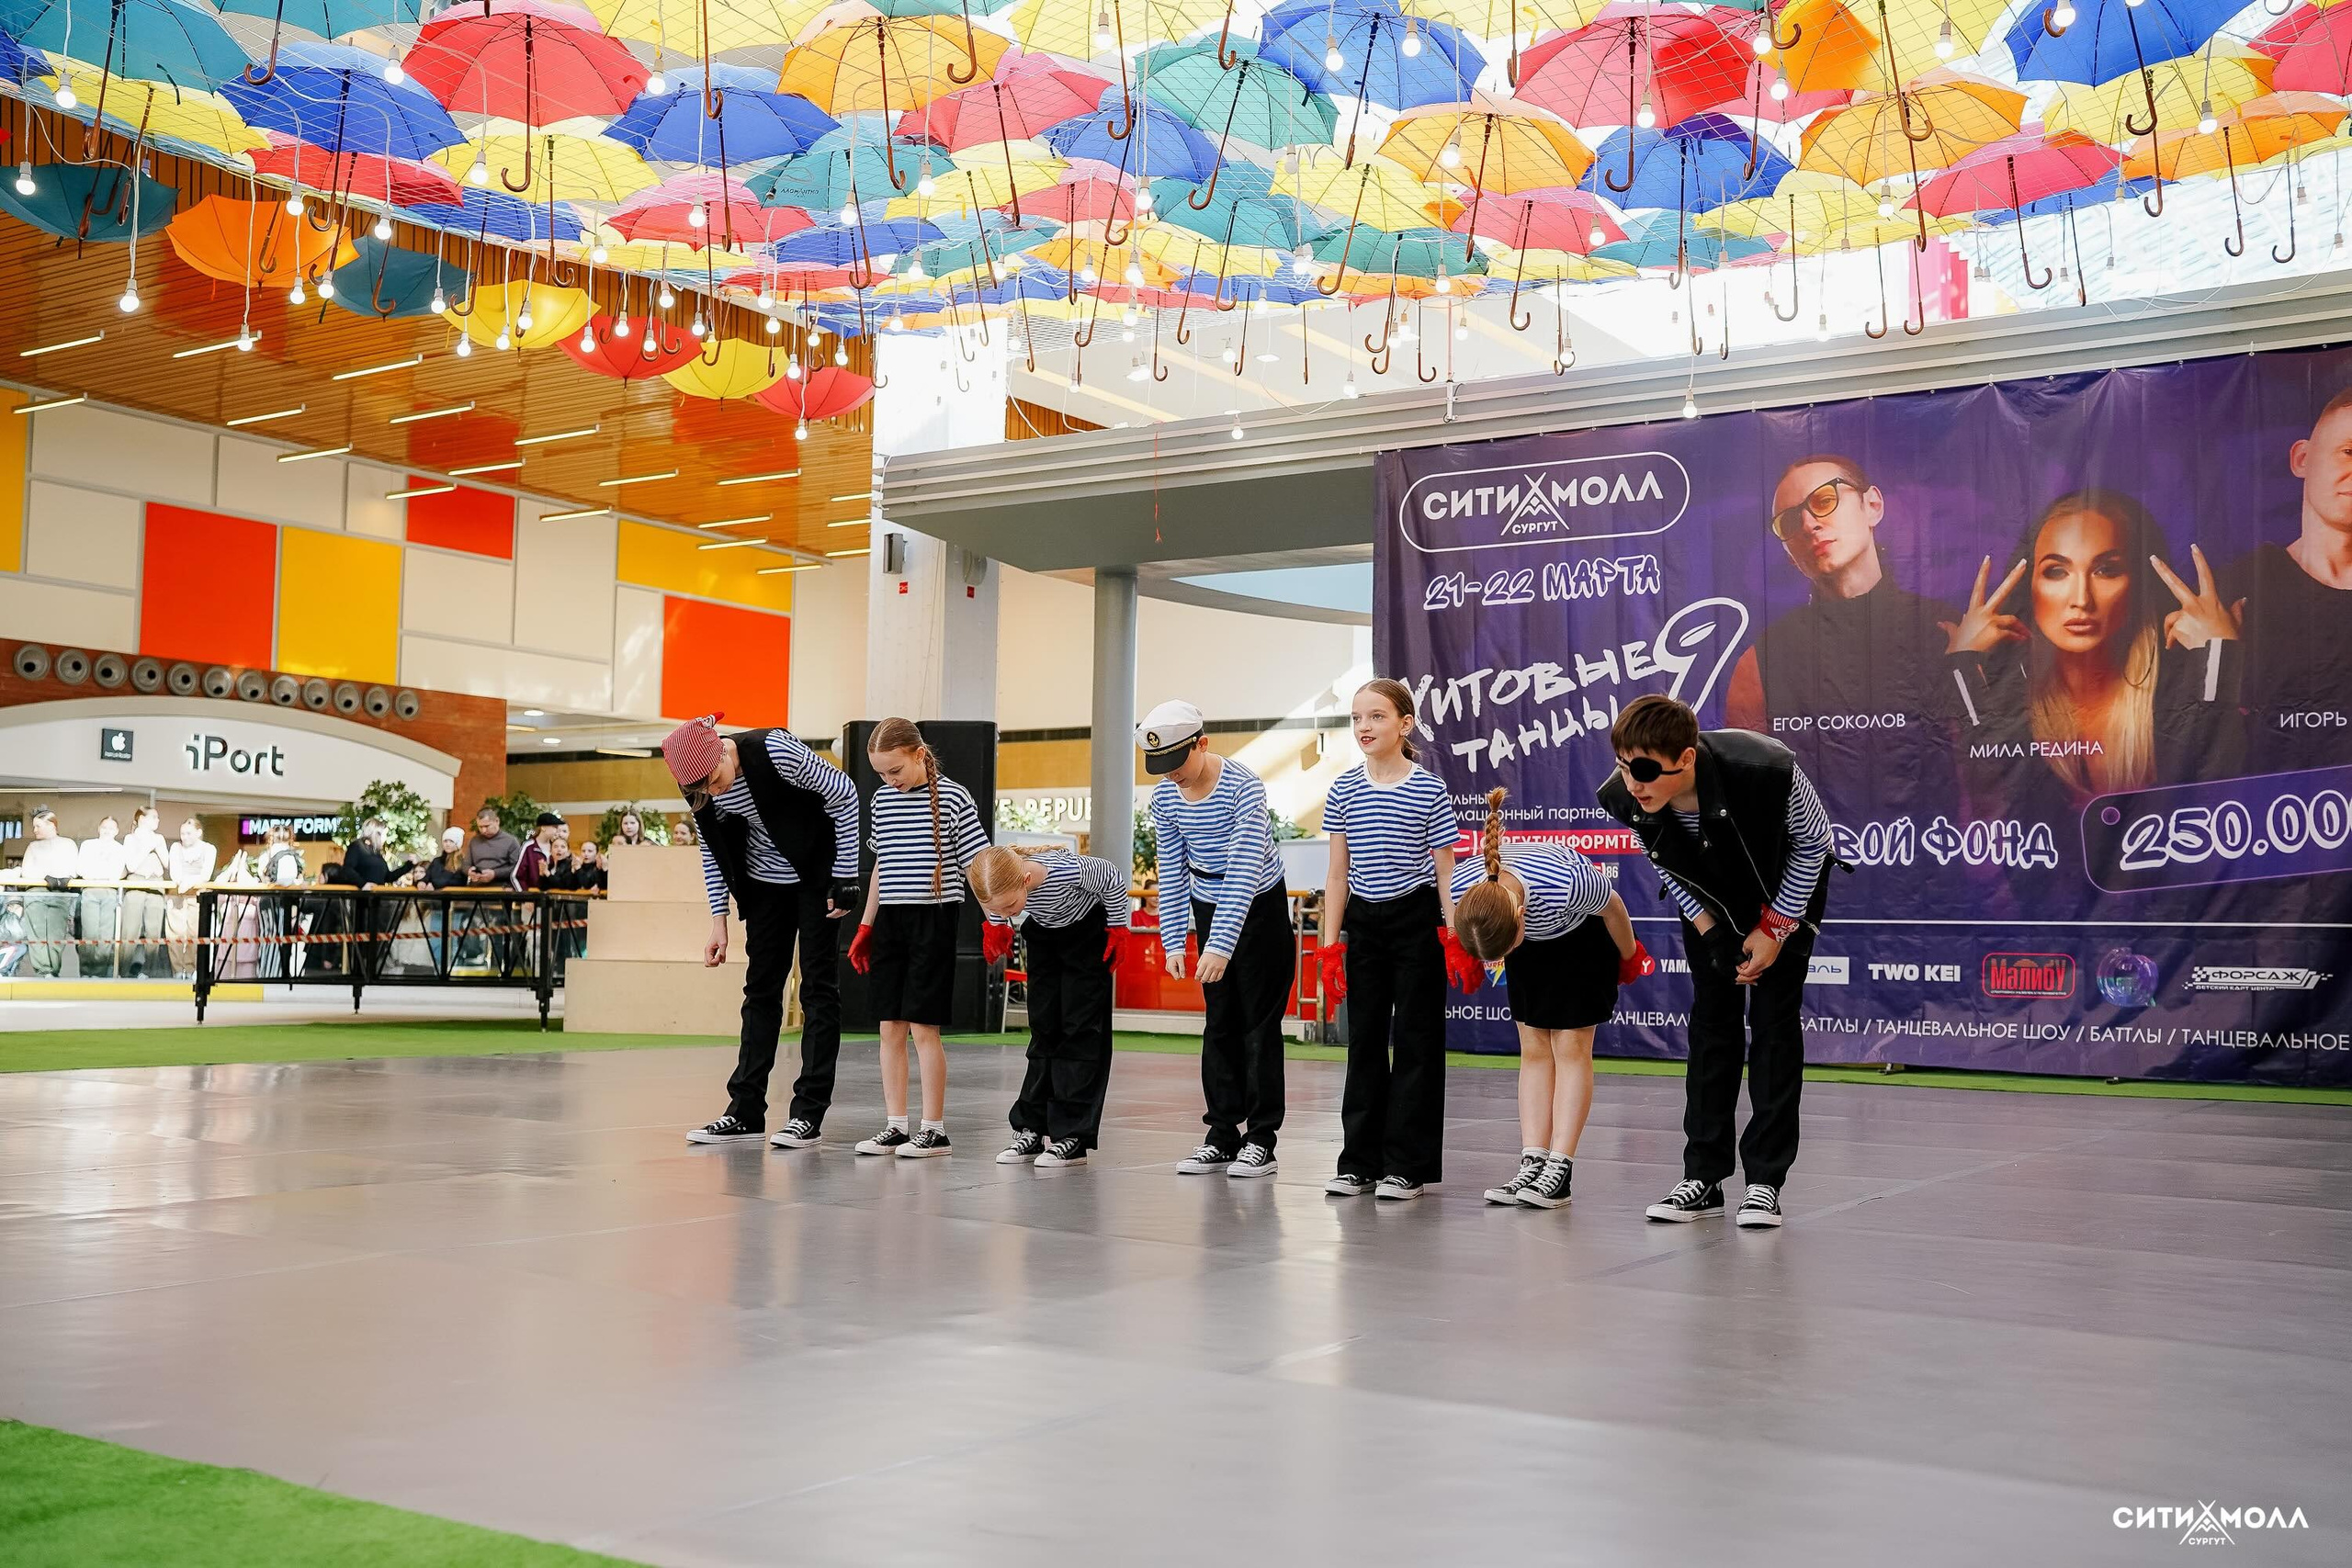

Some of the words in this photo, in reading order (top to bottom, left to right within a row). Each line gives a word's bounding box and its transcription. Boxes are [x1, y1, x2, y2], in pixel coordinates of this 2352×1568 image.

[1423, 483, 1520, 521] СИТИ
[1551, 470, 1664, 507] МОЛЛ
[1511, 520, 1558, 535] СУРГУТ
[1423, 569, 1536, 611] 21-22
[1543, 554, 1661, 602] МАРТА
[1451, 694, 1620, 773] ТАНЦЫ
[1773, 716, 1814, 731] ЕГОР
[1817, 713, 1906, 730] СОКОЛОВ
[2279, 711, 2348, 728] ИГОРЬ
[185, 734, 285, 776] iPort
[1969, 743, 2025, 760] МИЛА
[2030, 740, 2105, 758] РЕДИНА
[1831, 816, 1916, 865] ВОЙ
[1921, 816, 2059, 870] ФОНД
[2120, 788, 2352, 872] 250.00
[1868, 963, 1920, 982] TWO
[1924, 964, 1961, 982] KEI
[2211, 970, 2301, 982] ФОРСАЖ
[1609, 1010, 1690, 1028] АНЦЕВАЛ
[1876, 1019, 2018, 1039] ТАНЦЕВАЛЬНОЕ
[2022, 1024, 2072, 1042] ШОУ
[2089, 1026, 2161, 1043] БАТТЛЫ
[2181, 1028, 2350, 1051] ТАНЦЕВАЛЬНОЕ
